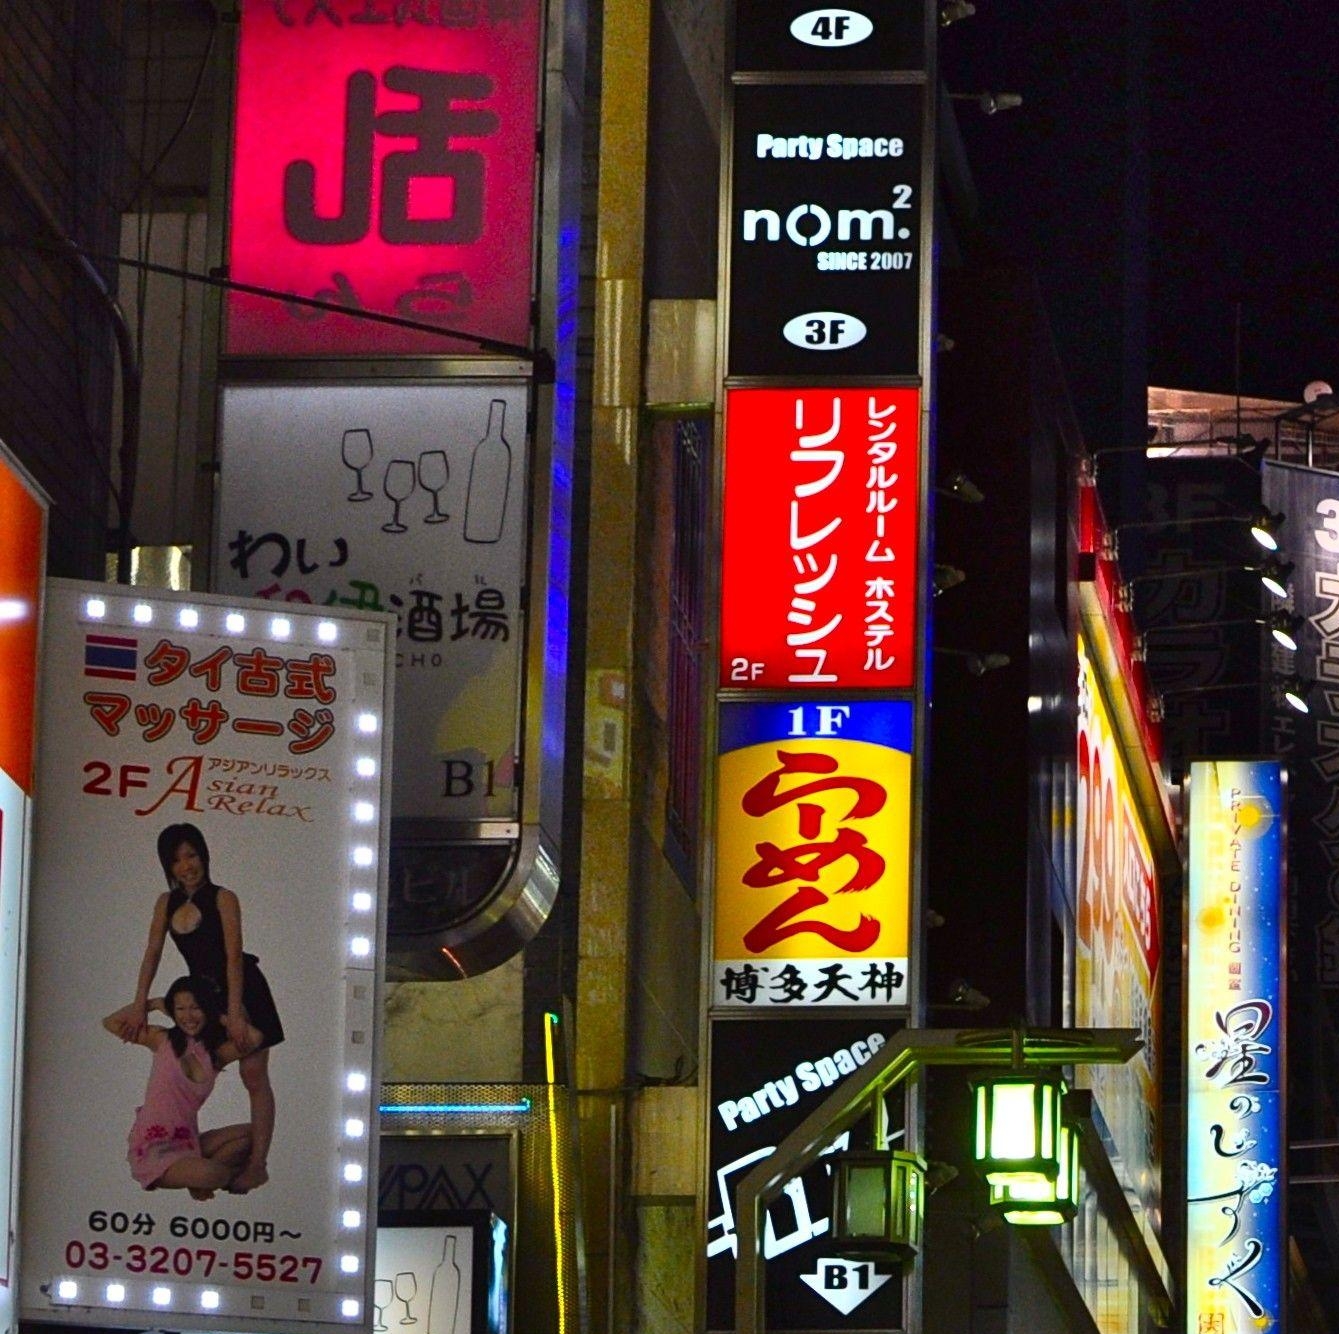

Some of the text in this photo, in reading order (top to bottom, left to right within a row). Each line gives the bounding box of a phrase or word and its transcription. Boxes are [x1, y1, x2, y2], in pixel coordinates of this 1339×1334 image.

[810, 15, 852, 41] 4F
[757, 134, 904, 160] Party Space
[817, 250, 913, 271] SINCE 2007
[805, 319, 845, 344] 3F
[229, 529, 348, 578] わい
[787, 396, 844, 684] リフレッシュ
[863, 397, 899, 672] レンタルルーム ホステル
[145, 638, 337, 703] タイ古式
[730, 658, 764, 681] 2F
[83, 691, 336, 755] マッサージ
[787, 705, 851, 737] 1F
[82, 761, 150, 799] 2F
[207, 757, 332, 783] アジアンリラックス
[442, 759, 497, 799] B1
[206, 796, 313, 823] Relax
[1230, 787, 1242, 873] PRIVATE
[742, 749, 887, 954] らーめん
[720, 963, 904, 1003] 博多天神
[718, 1030, 887, 1132] Party Space
[88, 1210, 156, 1236] 60分
[65, 1240, 323, 1284] 03-3207-5527
[824, 1265, 869, 1290] B1
